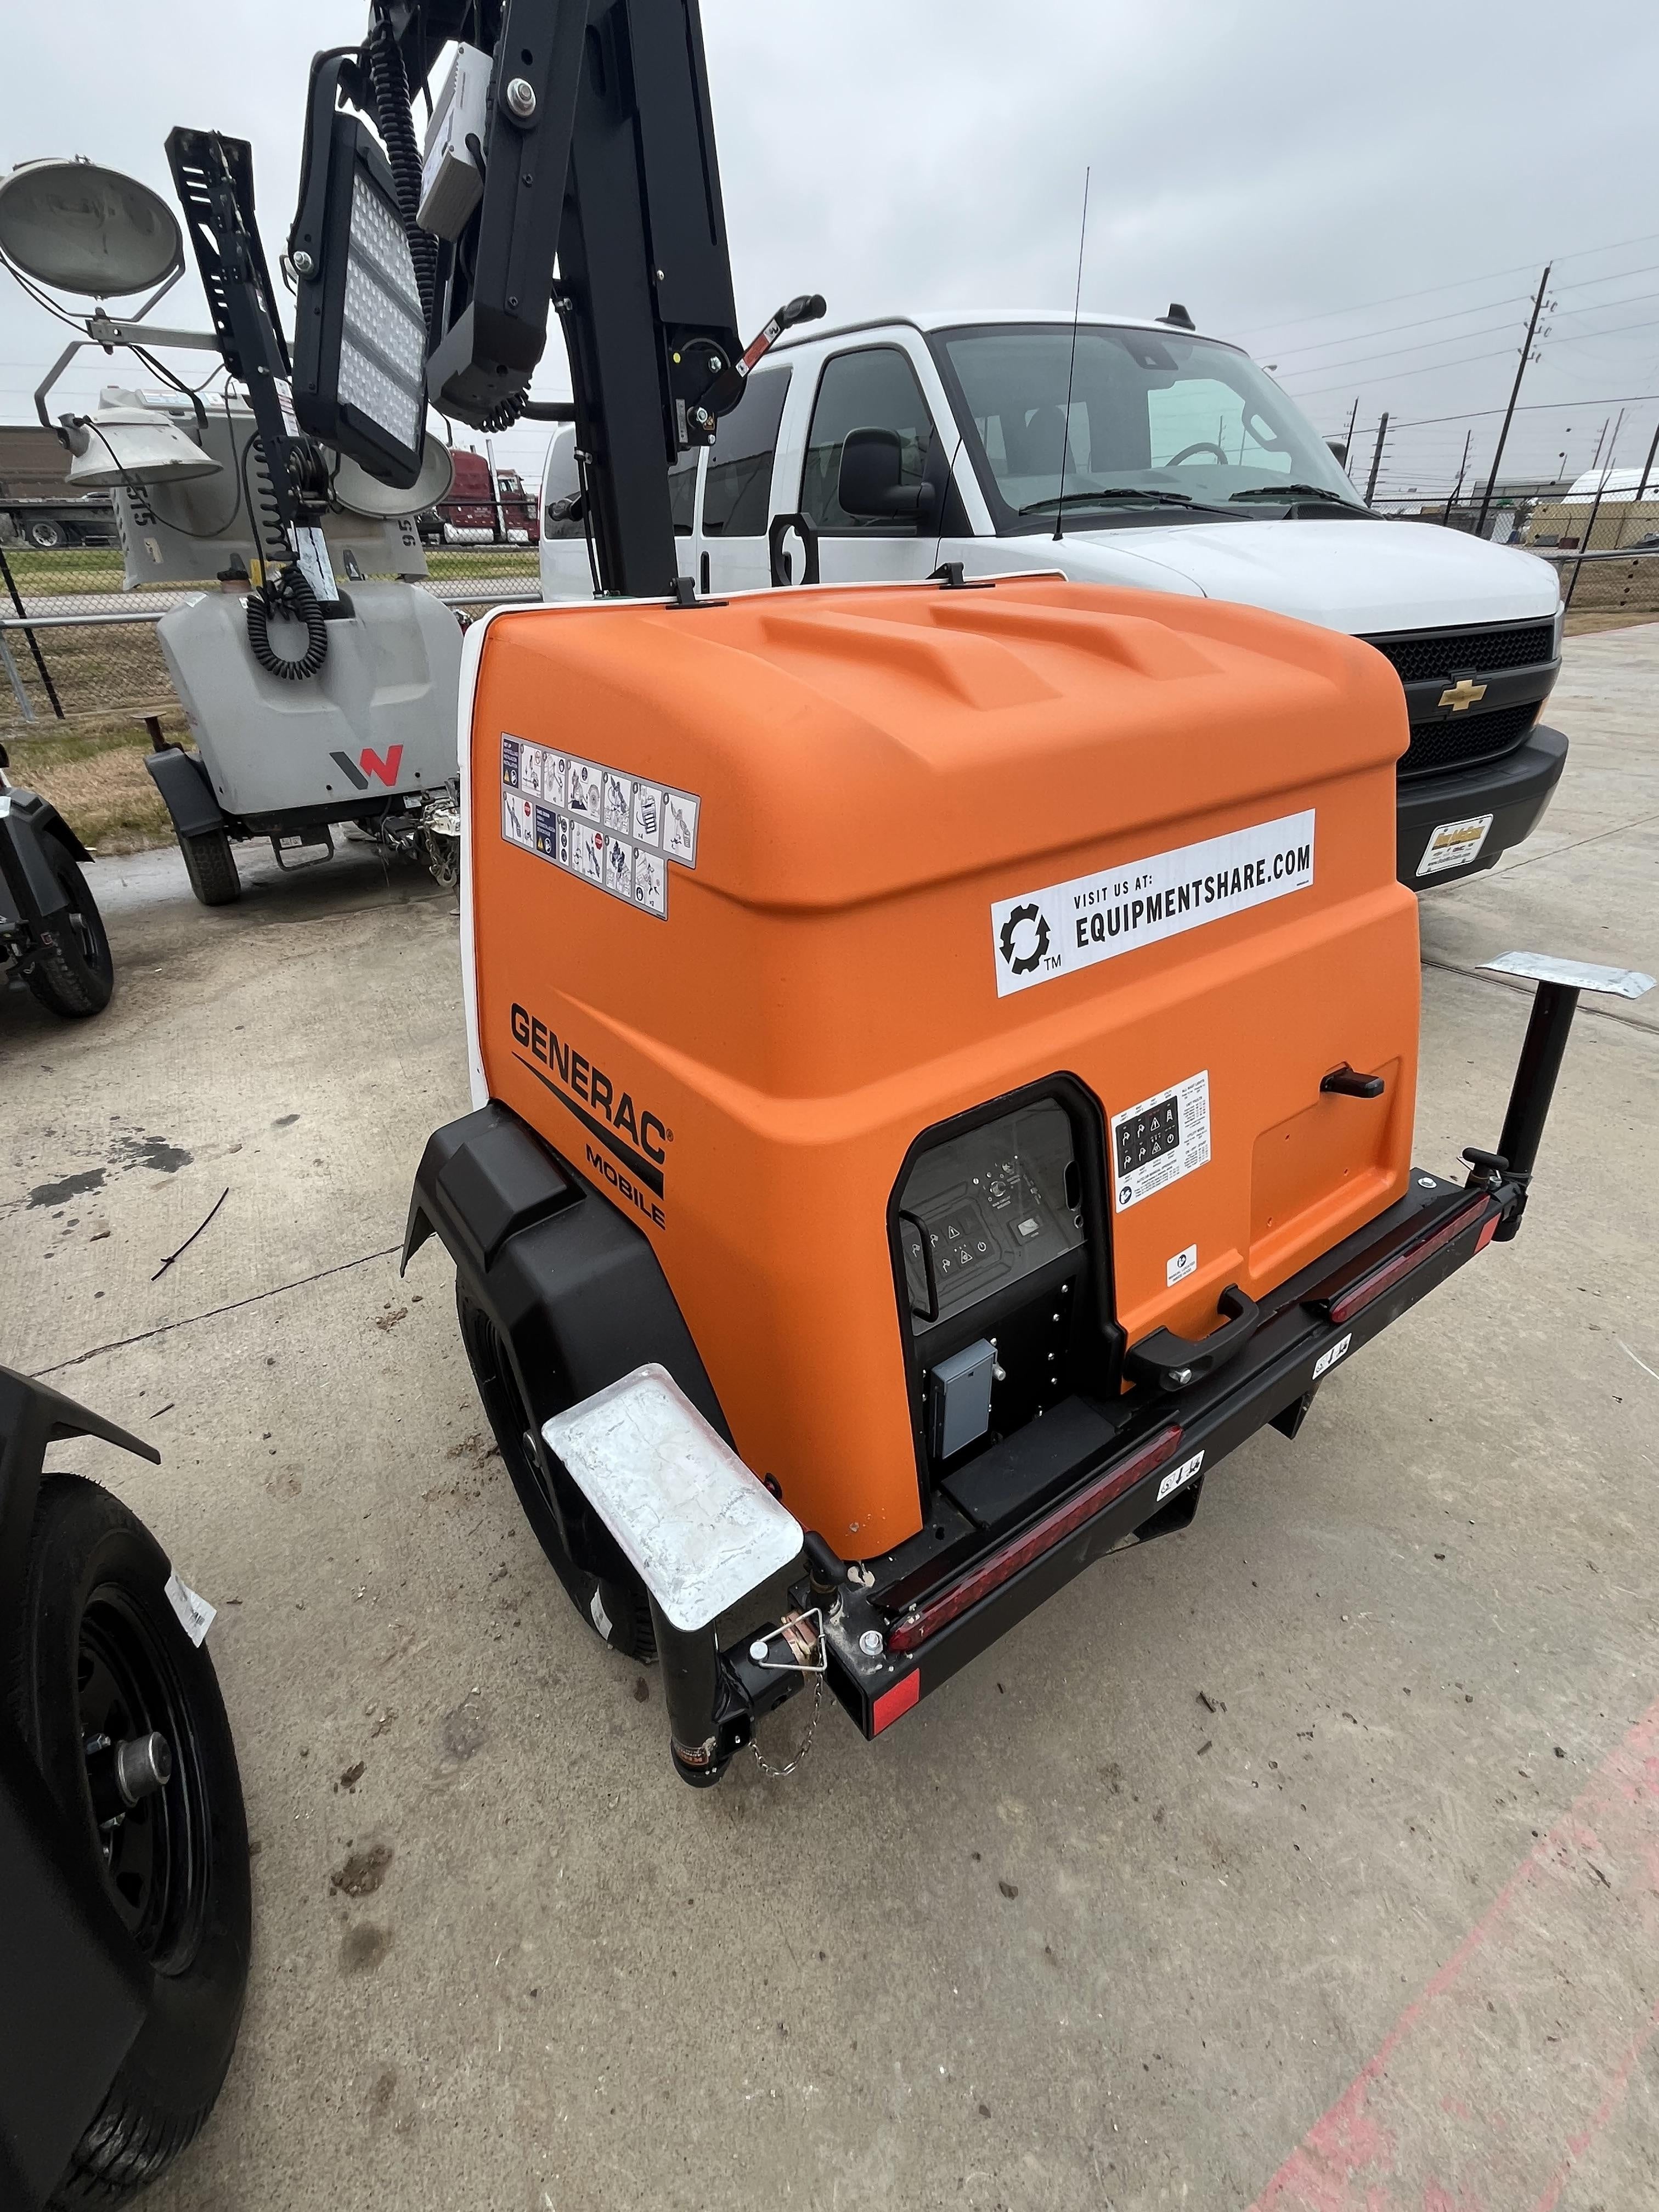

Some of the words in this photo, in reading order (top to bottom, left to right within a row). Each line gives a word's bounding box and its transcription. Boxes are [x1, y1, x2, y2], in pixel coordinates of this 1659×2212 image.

[1074, 887, 1108, 909] VISIT
[1114, 879, 1129, 898] US
[1135, 874, 1153, 891] AT:
[1075, 844, 1311, 949] EQUIPMENTSHARE.COM
[1044, 954, 1062, 971] TM
[586, 1143, 667, 1231] MOBILE
